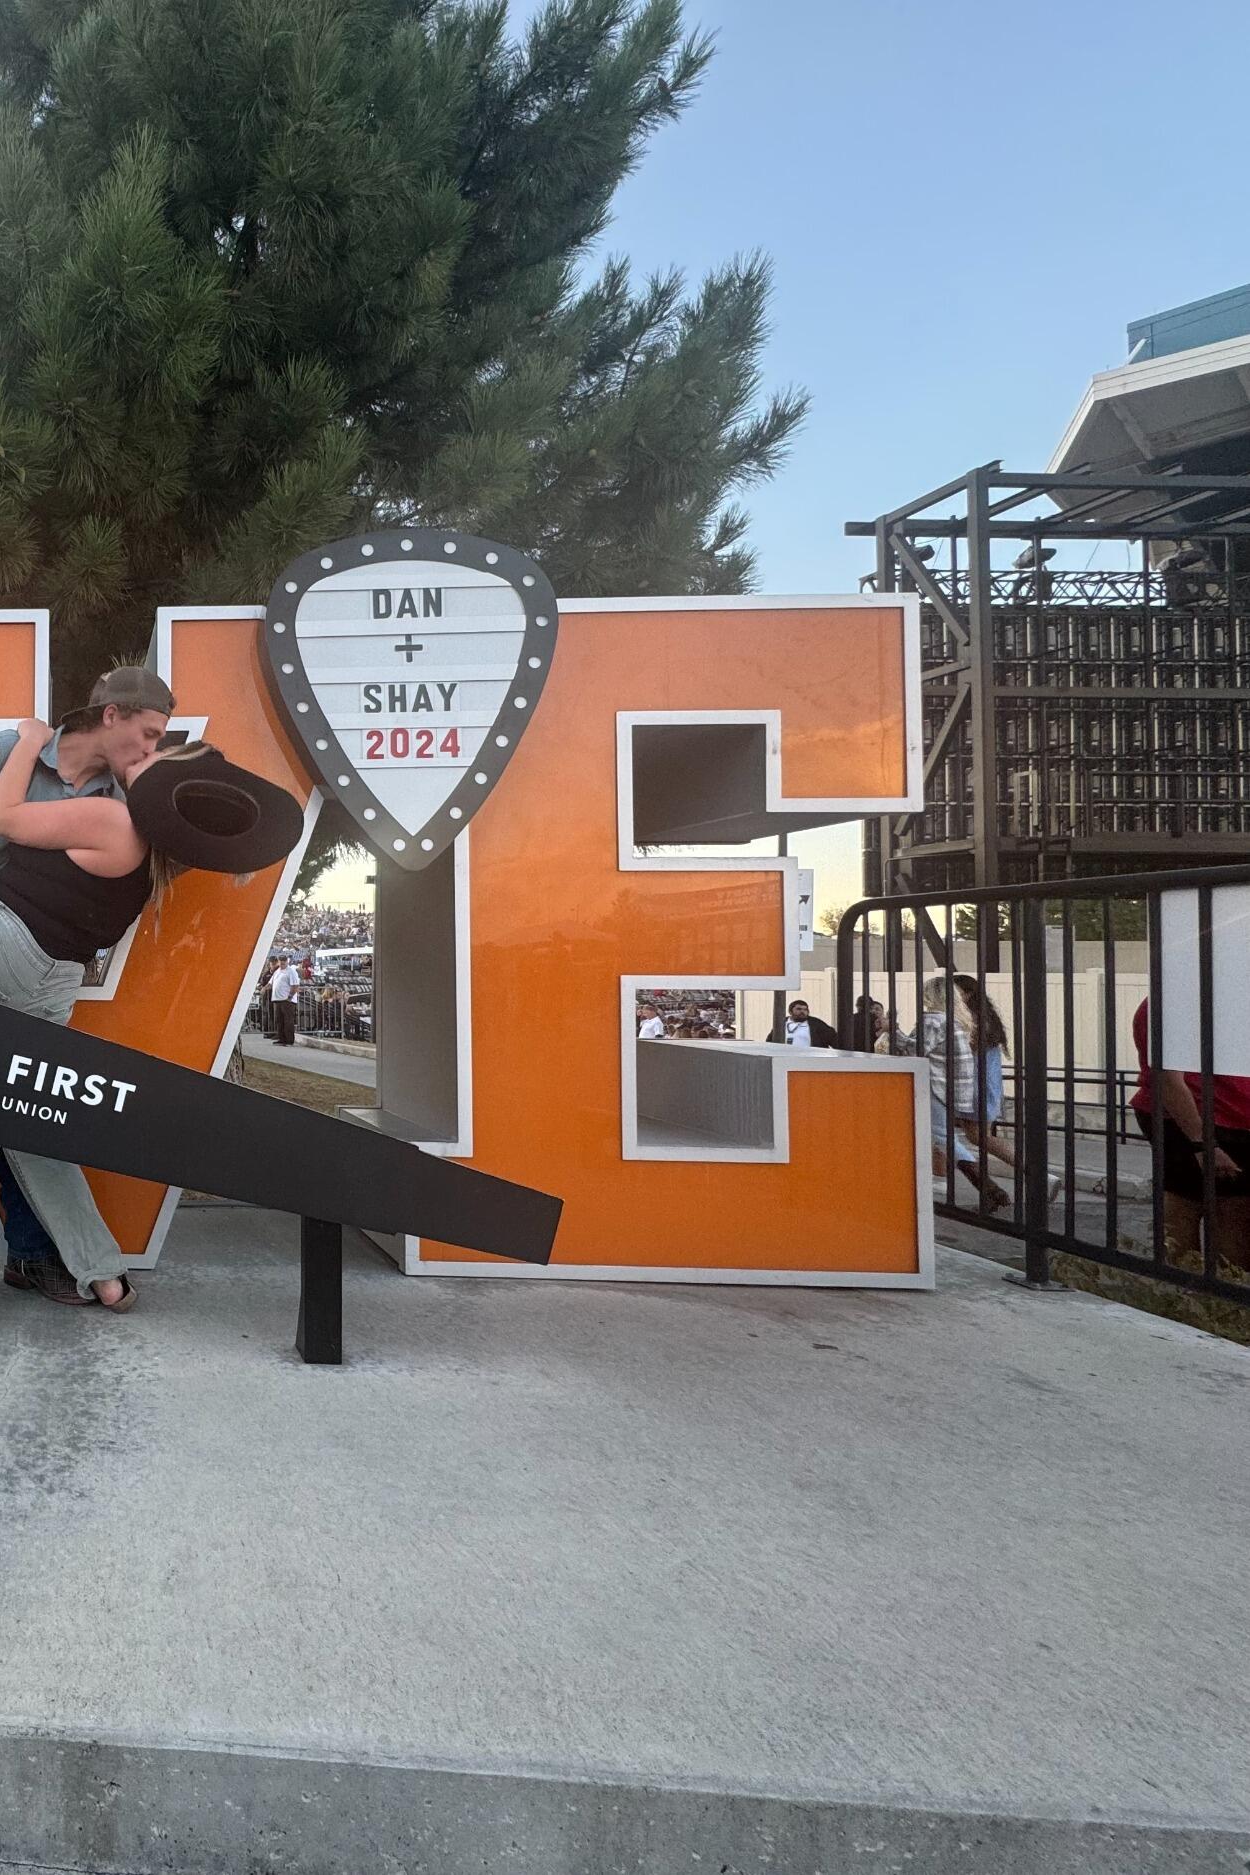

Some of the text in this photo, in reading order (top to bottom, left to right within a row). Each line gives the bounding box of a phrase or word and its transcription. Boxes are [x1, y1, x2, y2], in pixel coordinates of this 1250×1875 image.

[372, 587, 443, 620] DAN
[394, 634, 424, 663] +
[363, 683, 458, 713] SHAY
[366, 728, 461, 760] 2024
[6, 1054, 137, 1113] FIRST
[1, 1095, 69, 1126] UNION
